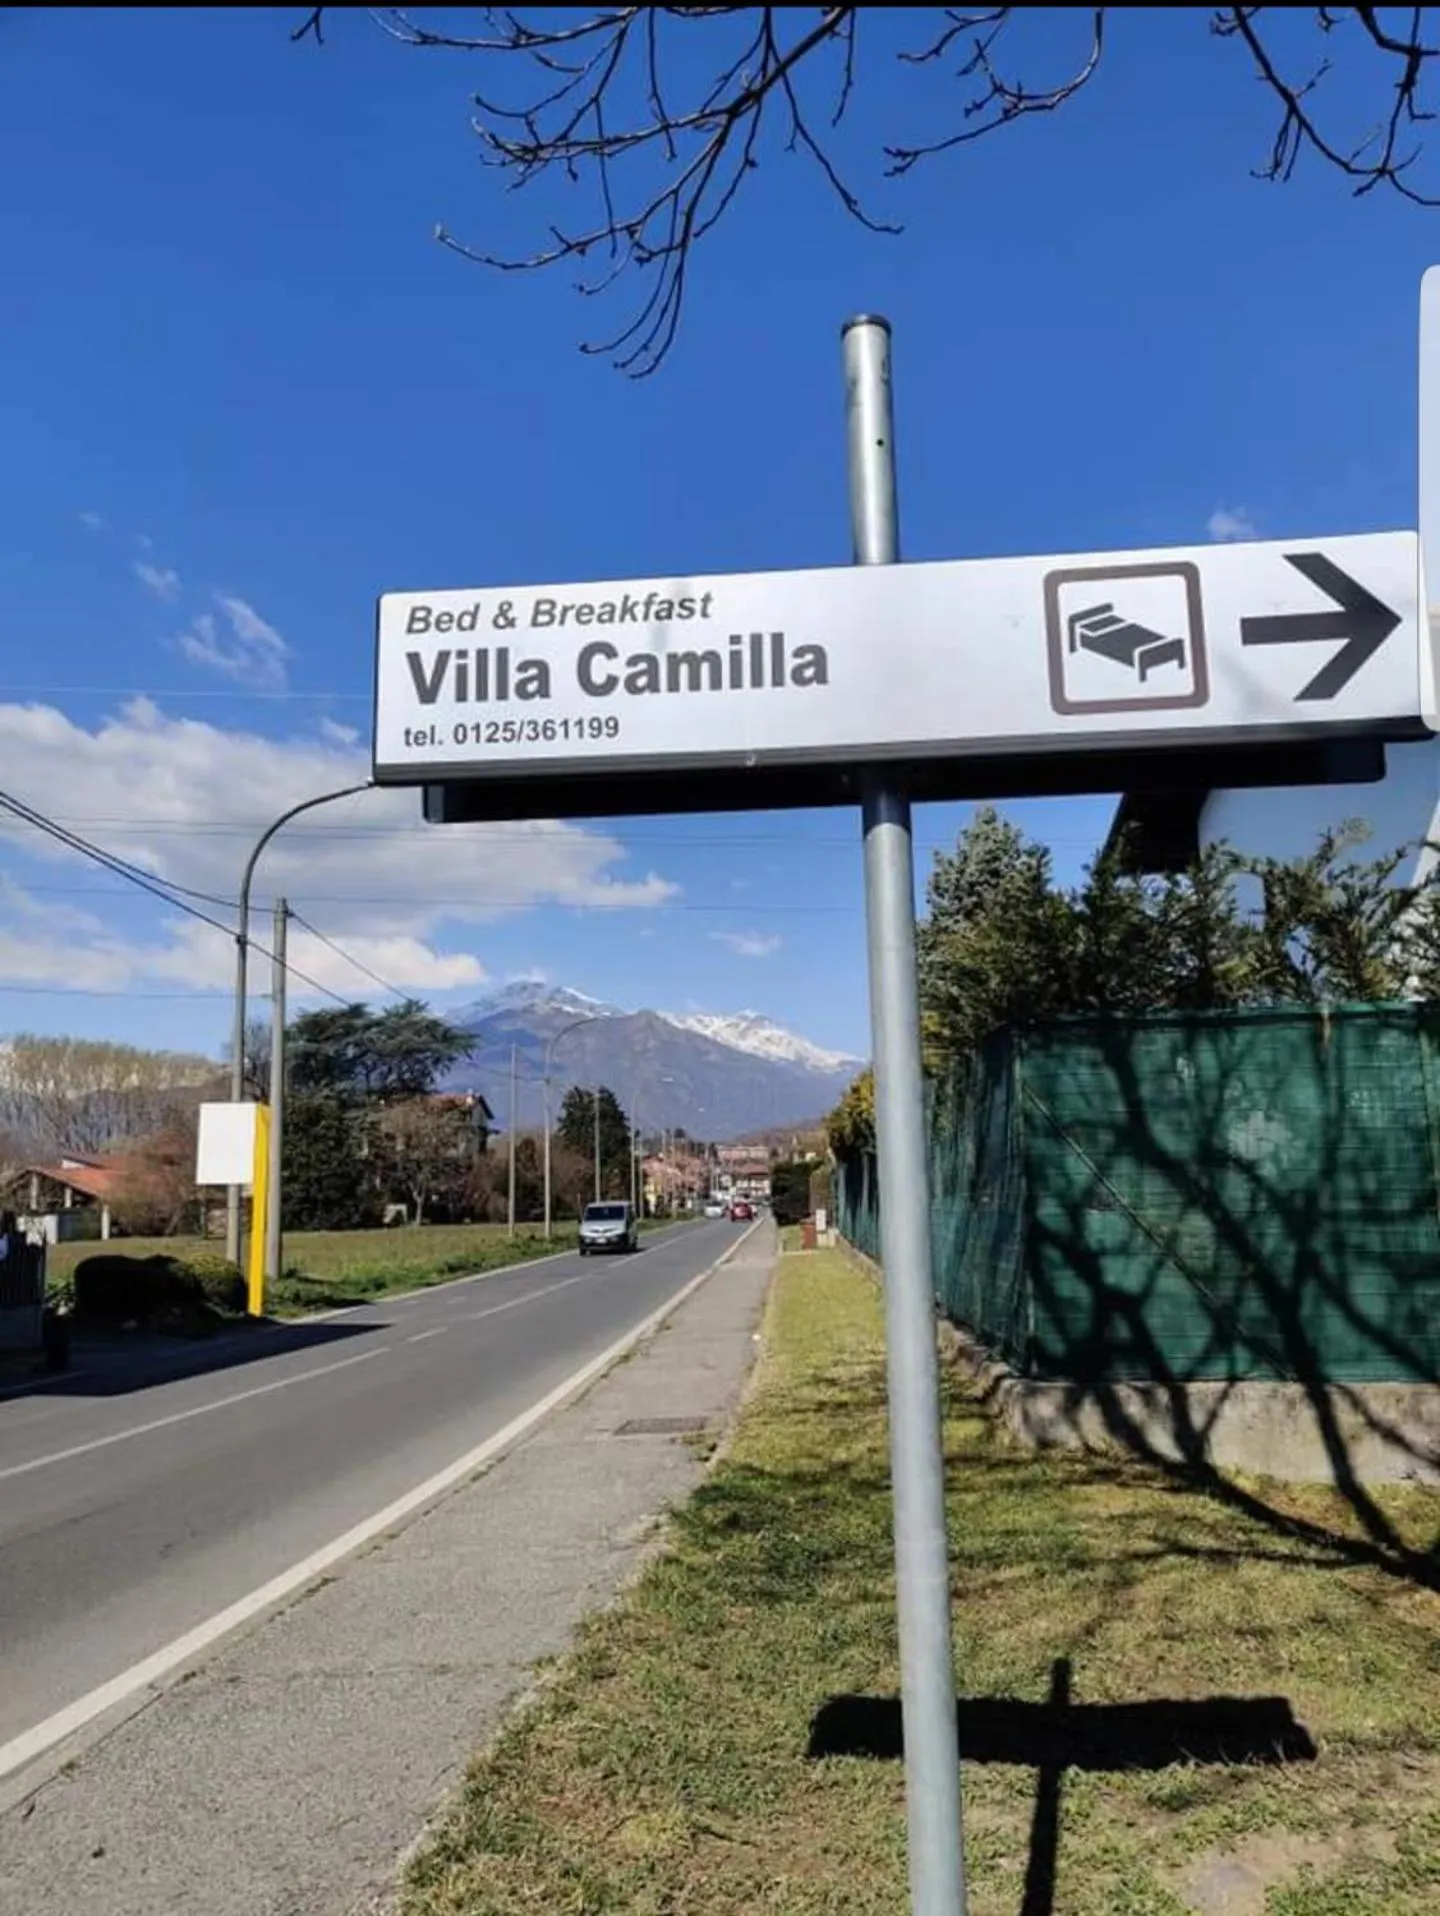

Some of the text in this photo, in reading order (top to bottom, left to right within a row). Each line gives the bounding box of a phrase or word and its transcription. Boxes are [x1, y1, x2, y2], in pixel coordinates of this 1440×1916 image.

[406, 591, 713, 634] Bed & Breakfast
[406, 632, 829, 705] Villa Camilla
[404, 715, 619, 747] tel. 0125/361199
